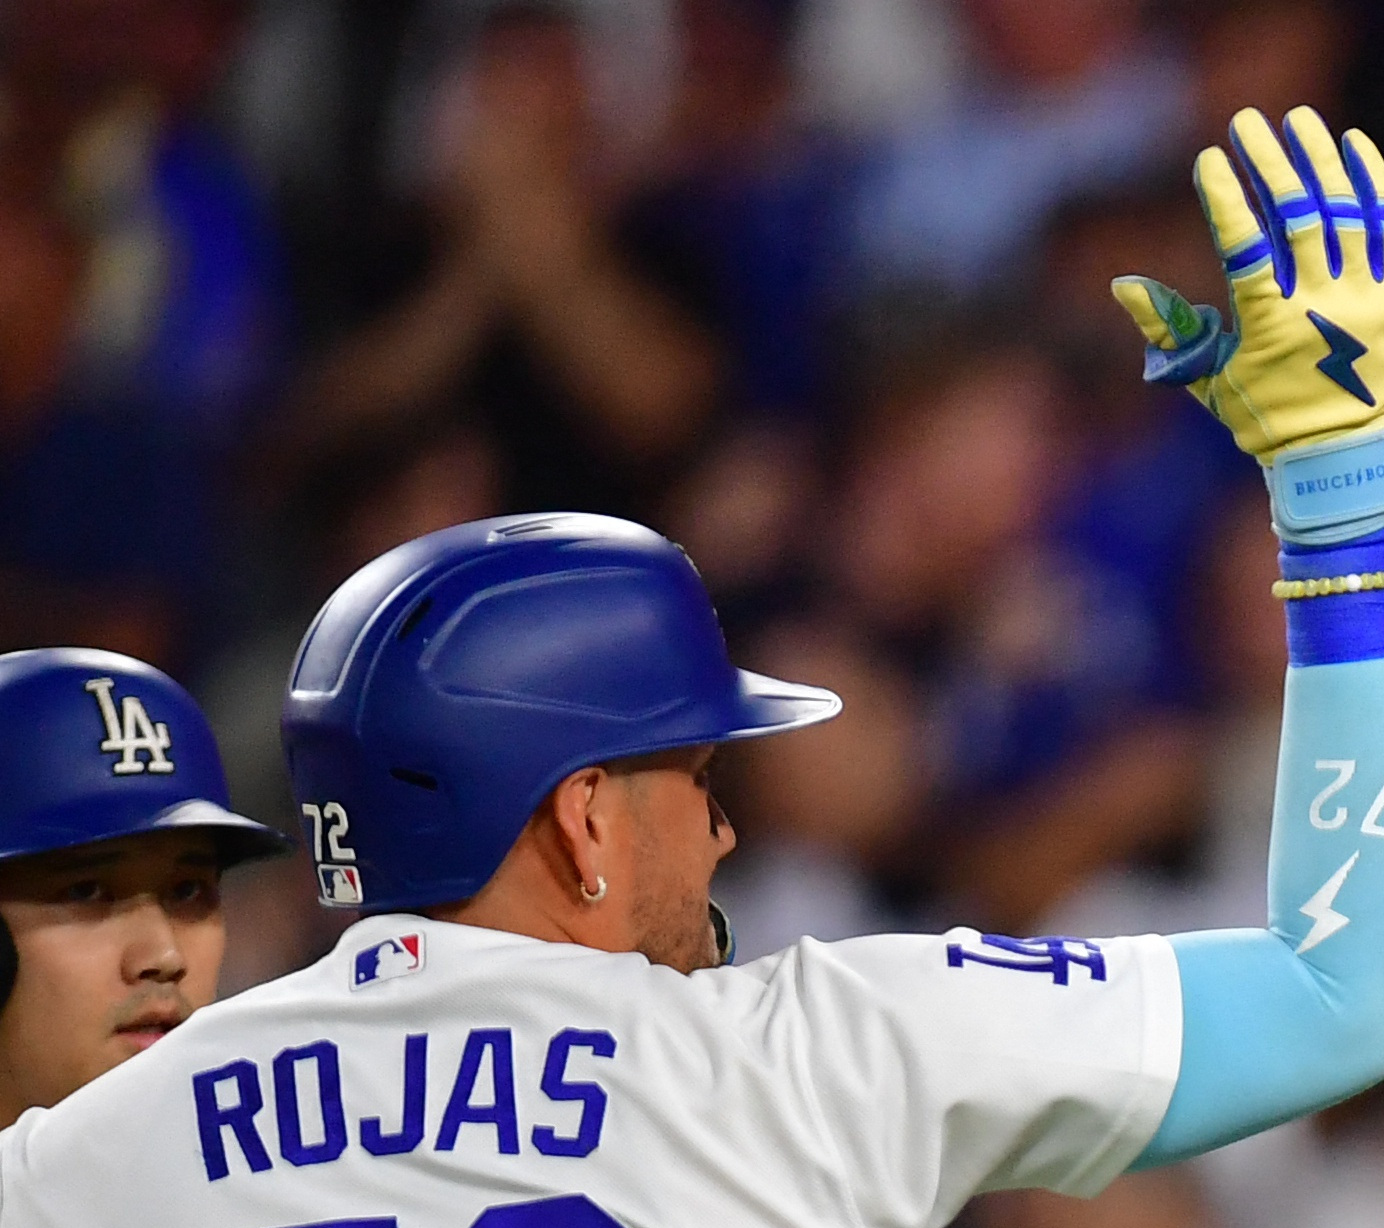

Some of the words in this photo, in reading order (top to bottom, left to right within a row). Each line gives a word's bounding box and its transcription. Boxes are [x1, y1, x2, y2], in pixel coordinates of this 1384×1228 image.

[1294, 473, 1354, 496] BRUCE
[84, 676, 175, 776] LA
[301, 801, 357, 862] 72
[192, 1026, 618, 1182] ROJAS
